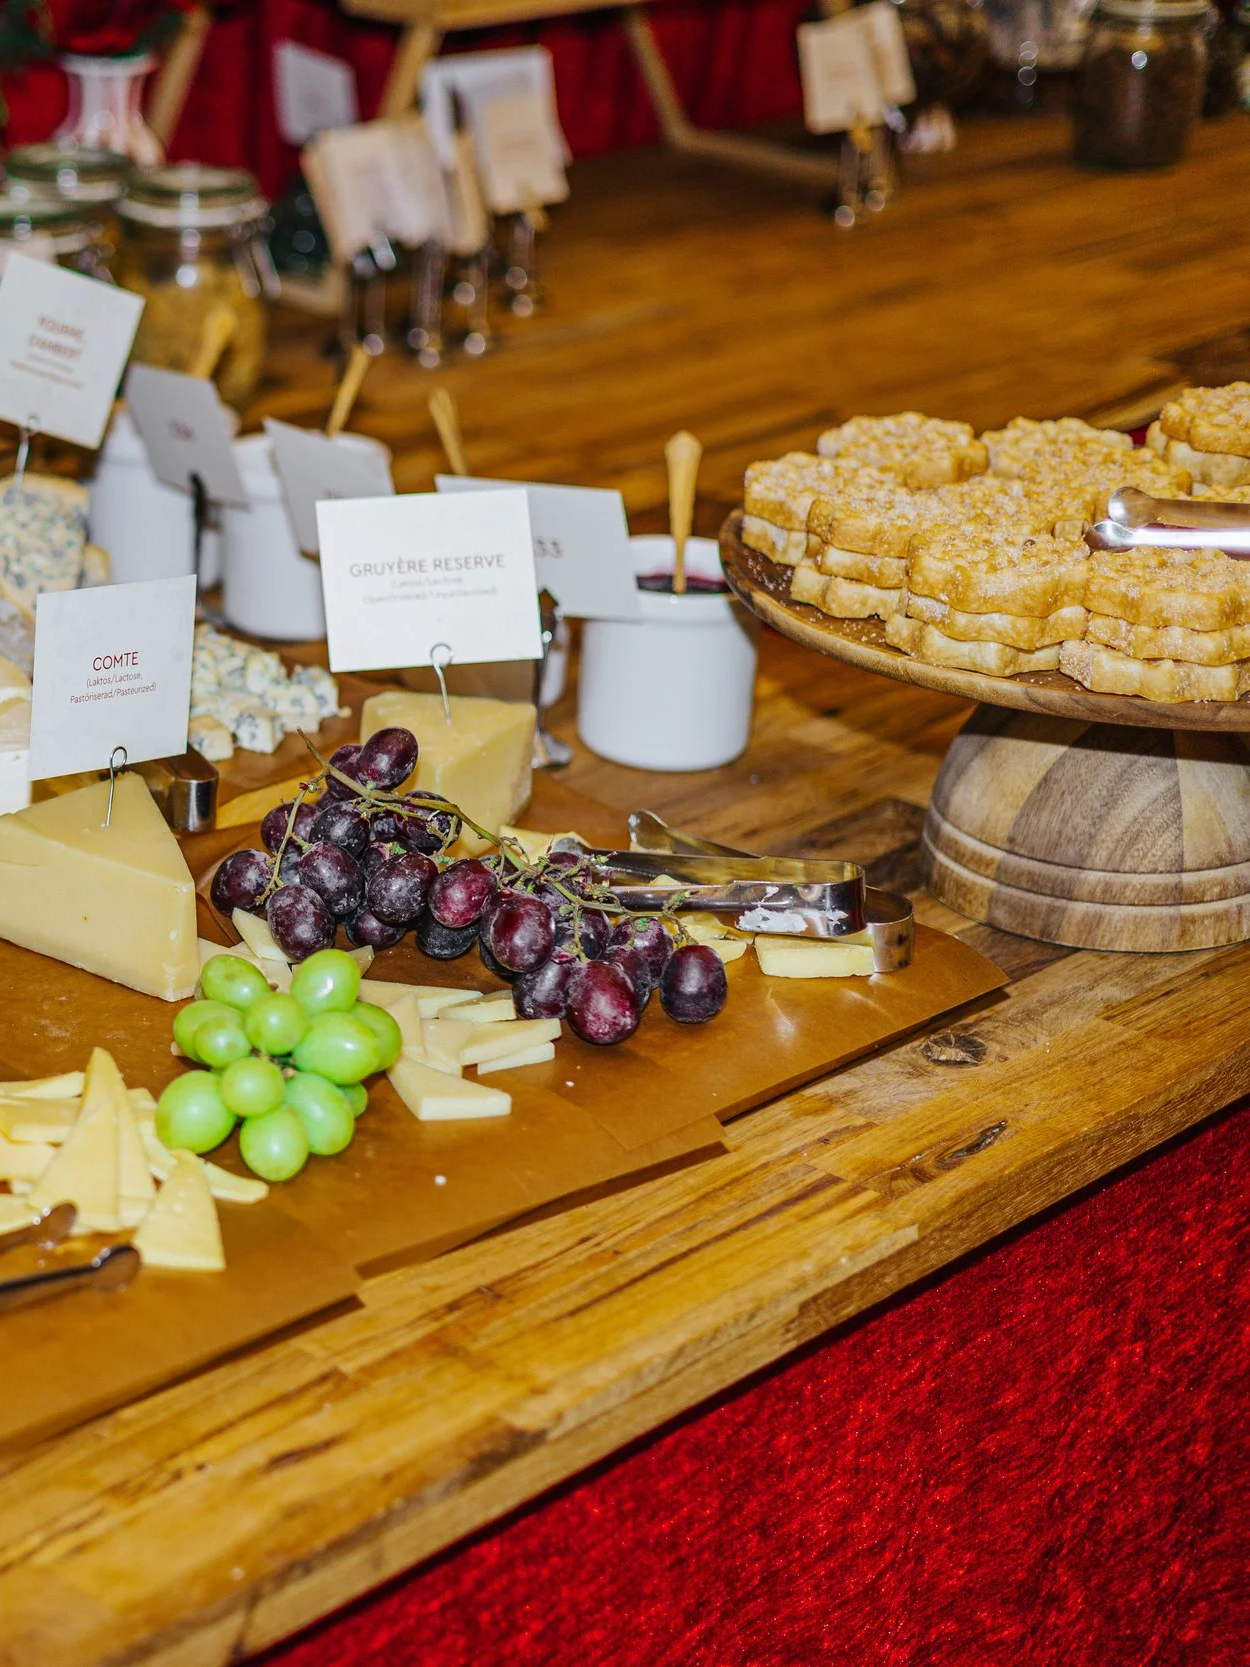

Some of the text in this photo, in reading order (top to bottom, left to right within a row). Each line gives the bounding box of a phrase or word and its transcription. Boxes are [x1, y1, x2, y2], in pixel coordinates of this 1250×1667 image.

[350, 553, 506, 578] GRUYÈRE RESERVE
[92, 651, 139, 671] COMTE
